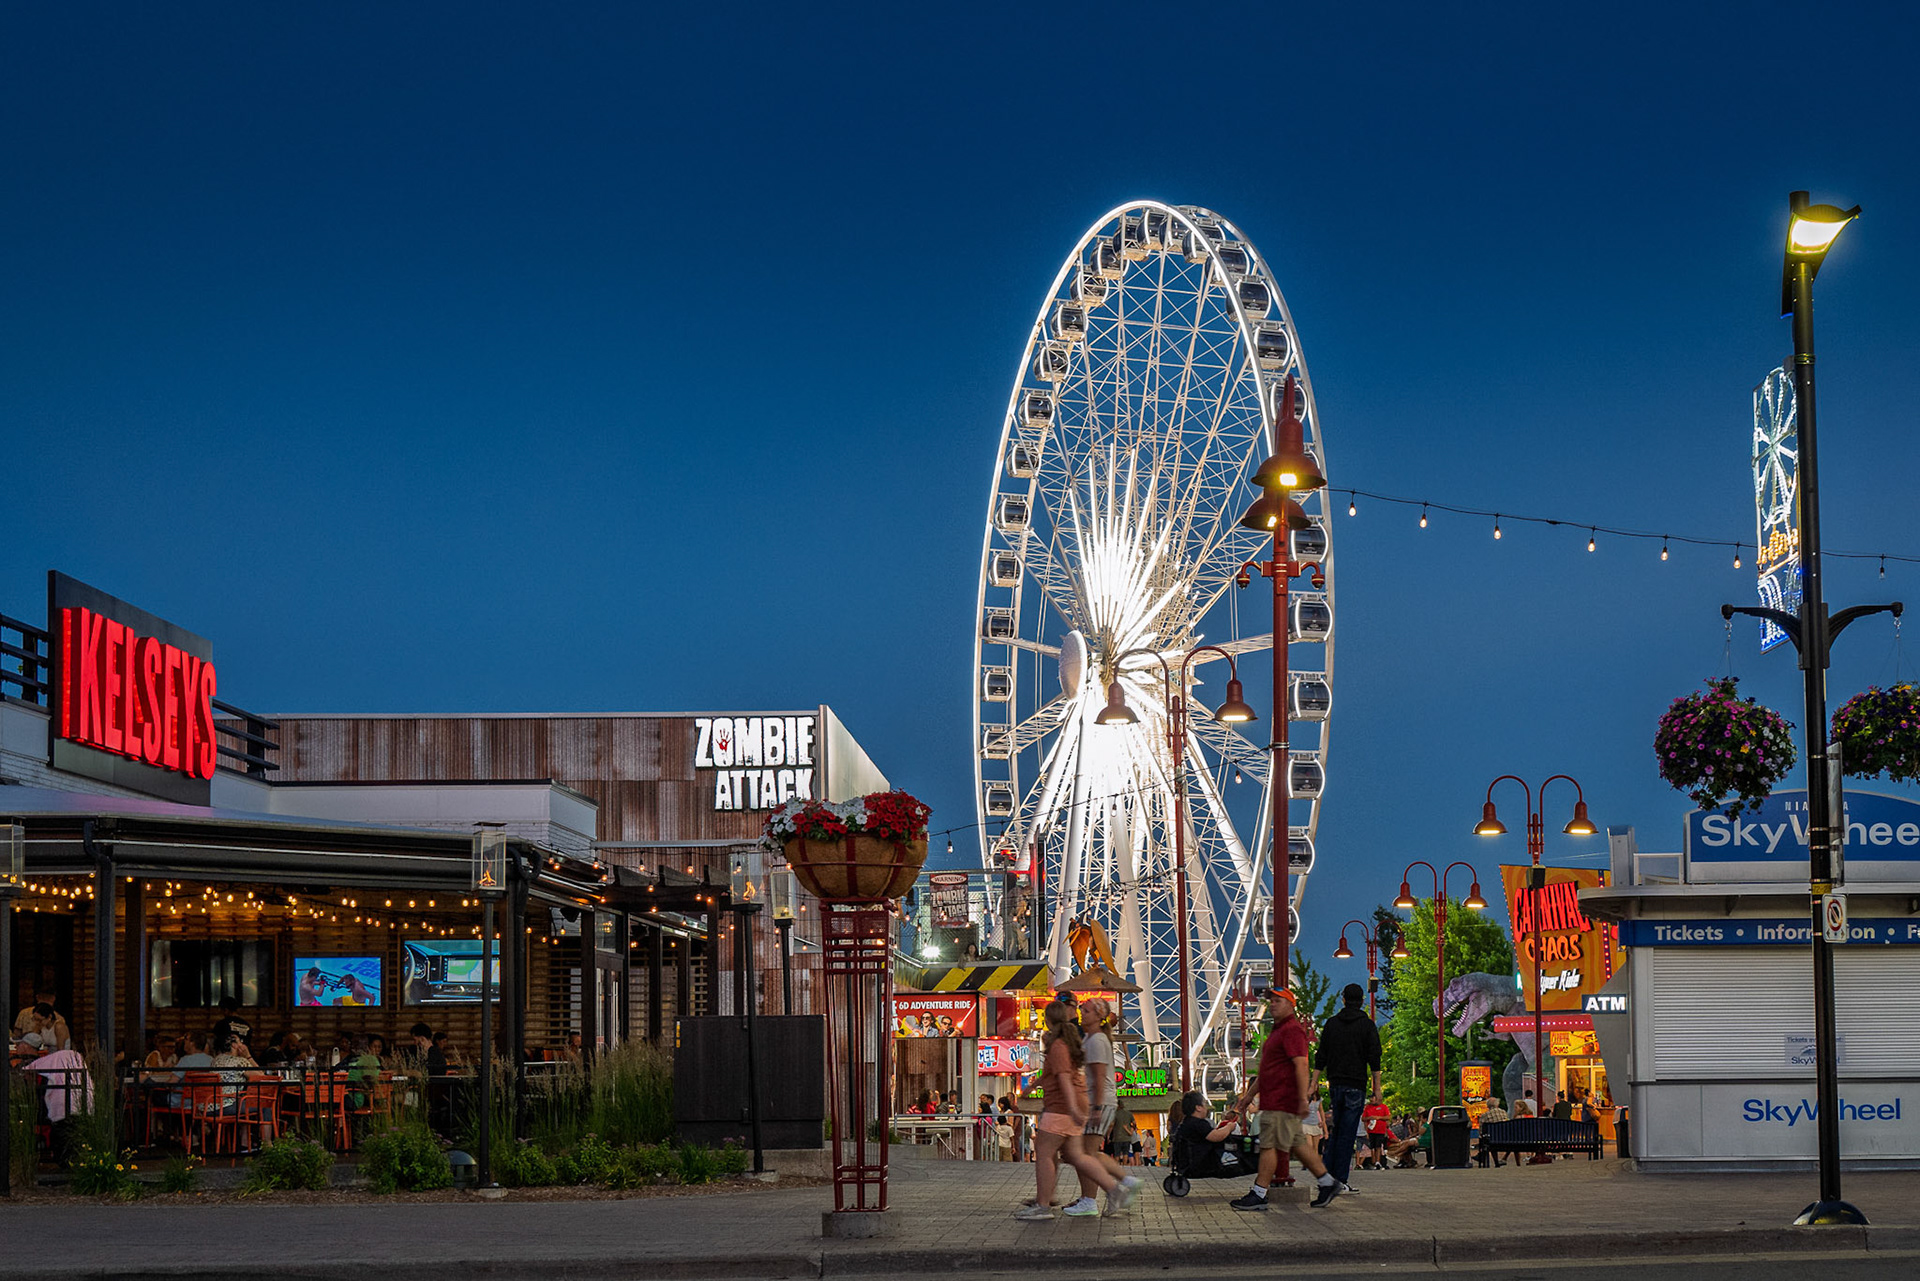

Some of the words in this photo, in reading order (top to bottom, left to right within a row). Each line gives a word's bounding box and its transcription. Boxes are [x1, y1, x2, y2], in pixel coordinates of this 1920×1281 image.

[79, 606, 217, 780] KELSEYS
[695, 716, 814, 767] ZOMBIE
[715, 768, 814, 810] ATTACK
[1785, 801, 1849, 811] NIAA
[931, 889, 966, 907] ZOMBIE
[1513, 881, 1592, 942] CANIVAL
[1654, 925, 1724, 940] Tickets
[898, 1001, 909, 1010] 6D
[910, 1001, 953, 1010] ADVENTURE
[954, 1000, 971, 1009] RIDE
[1586, 996, 1625, 1011] ATM
[978, 1049, 995, 1062] CEE
[1116, 1088, 1148, 1097] ENTURE
[1148, 1087, 1169, 1096] GOLF
